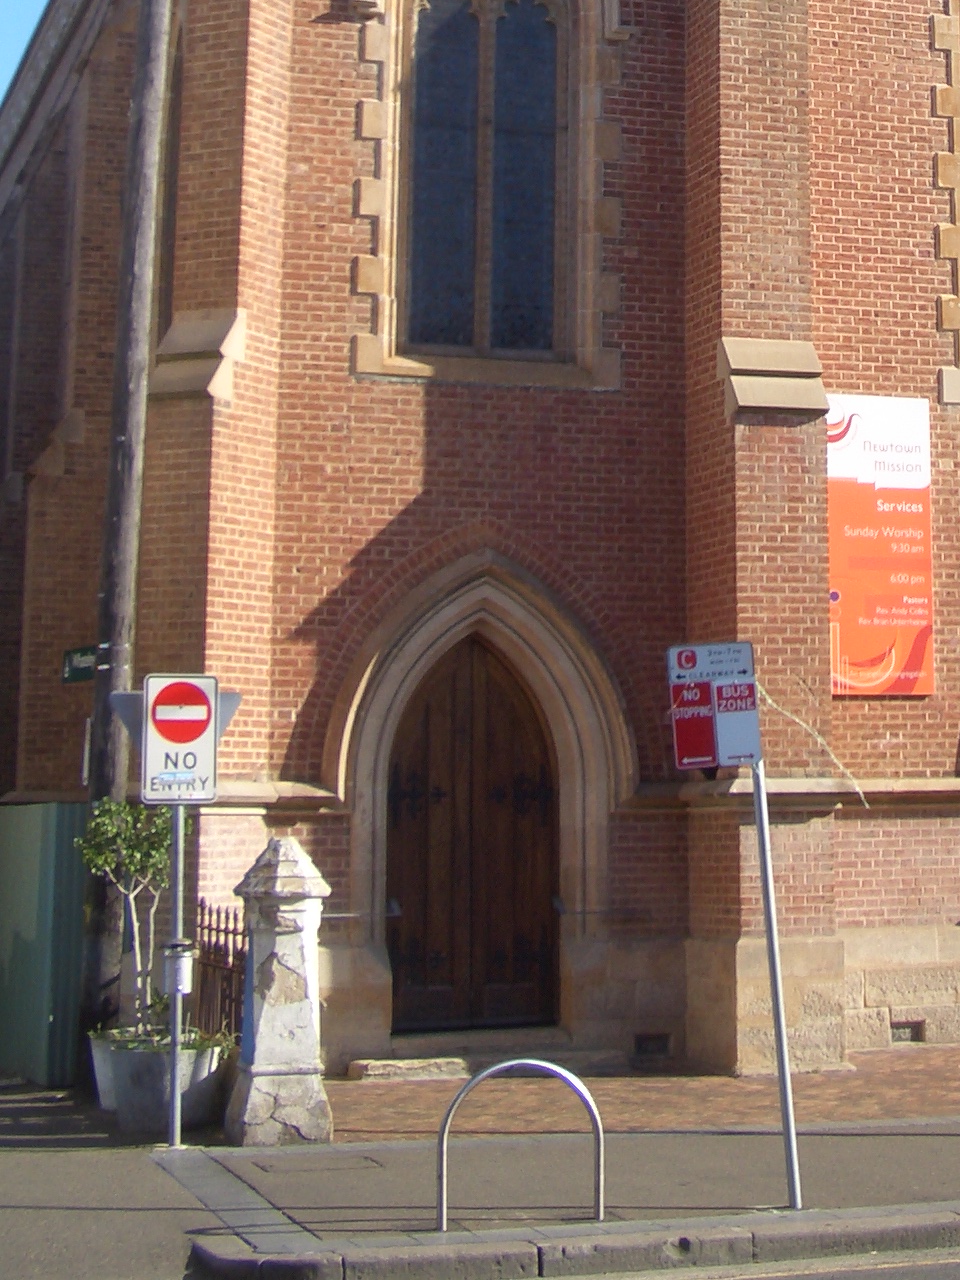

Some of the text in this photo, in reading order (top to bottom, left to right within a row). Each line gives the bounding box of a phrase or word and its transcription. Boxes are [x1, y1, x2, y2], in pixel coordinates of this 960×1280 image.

[863, 440, 922, 454] Newtown
[874, 460, 922, 473] Mission
[876, 499, 924, 513] Services
[844, 525, 924, 540] Sunday Worship
[891, 543, 925, 553] 9:30 am
[890, 573, 925, 585] 6:00 pm
[681, 651, 693, 669] C
[682, 689, 700, 701] NO
[722, 685, 749, 698] BUS
[719, 697, 754, 710] ZONE
[164, 751, 197, 770] NO
